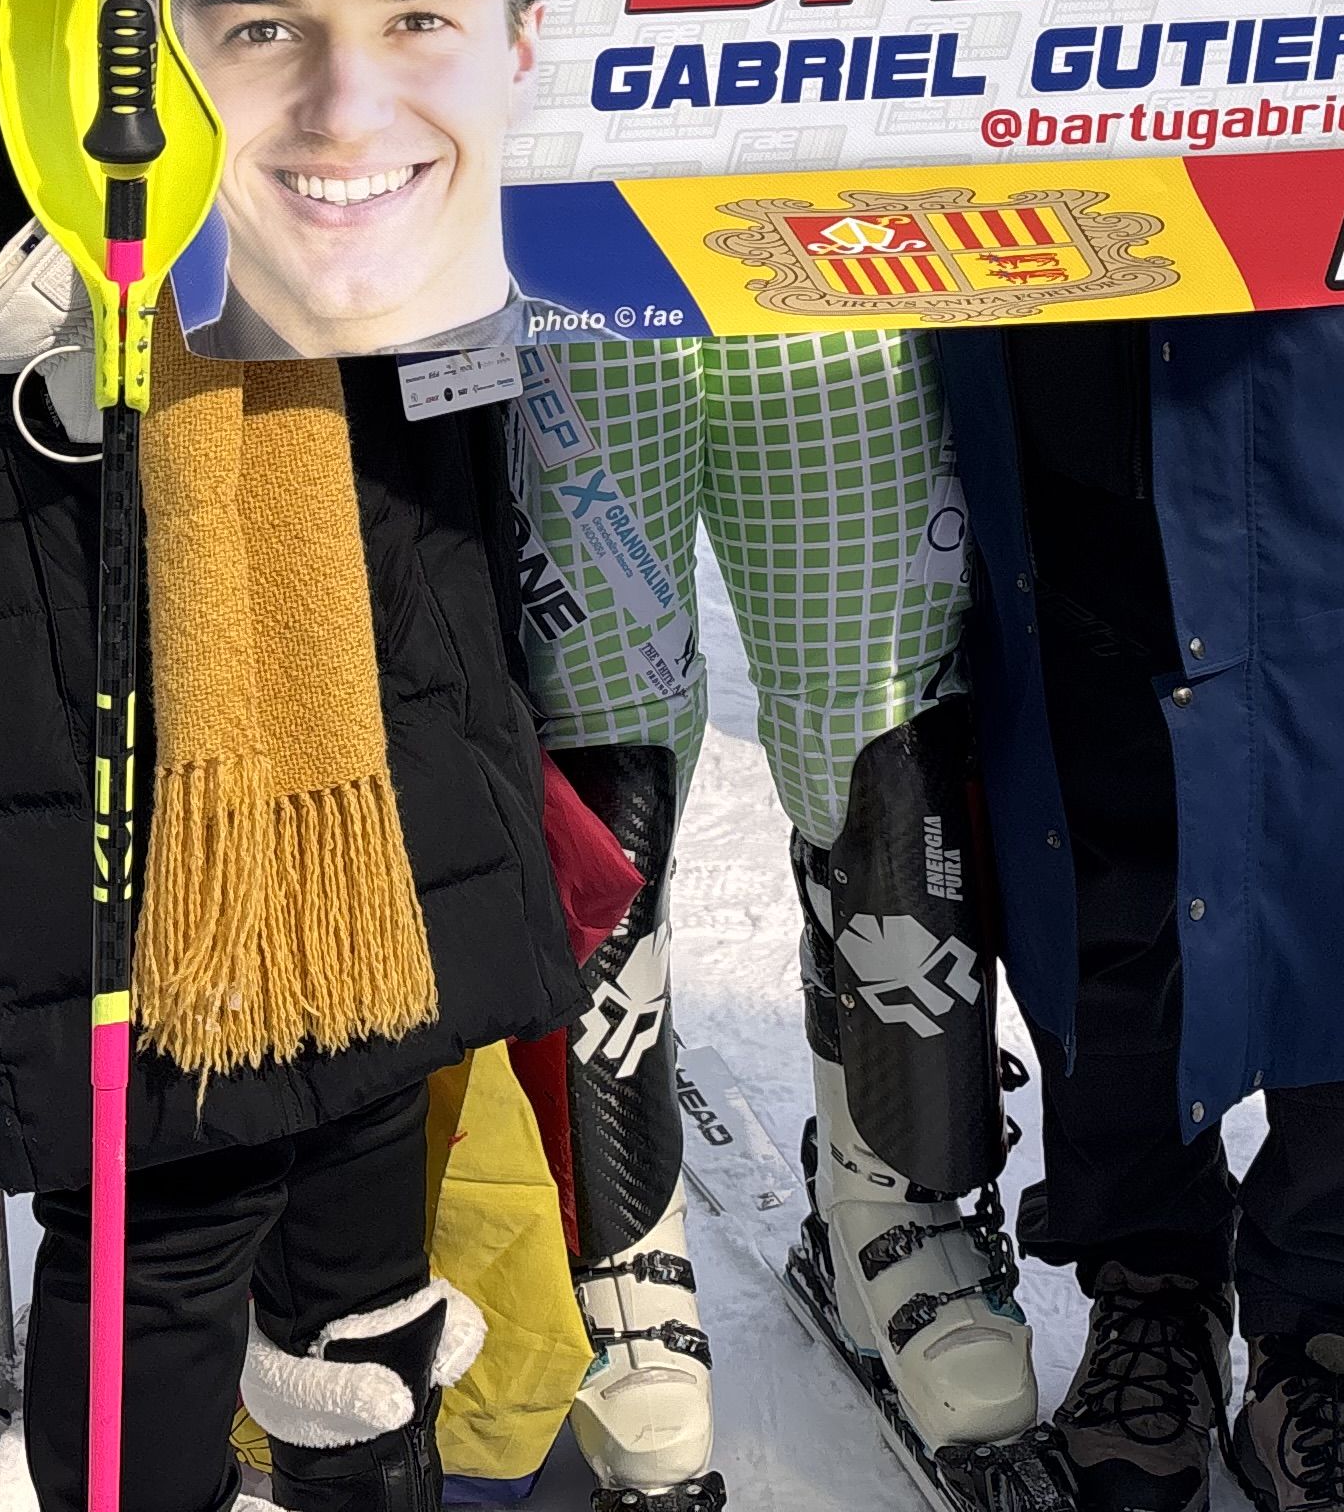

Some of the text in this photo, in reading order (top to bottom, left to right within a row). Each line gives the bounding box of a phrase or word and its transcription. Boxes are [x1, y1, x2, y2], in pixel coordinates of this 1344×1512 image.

[591, 32, 986, 111] GABRIEL
[528, 309, 605, 338] photo
[643, 304, 684, 327] fae
[606, 505, 676, 609] GRANDVALIRA
[923, 815, 946, 899] ENERGIA
[944, 848, 964, 902] PURA
